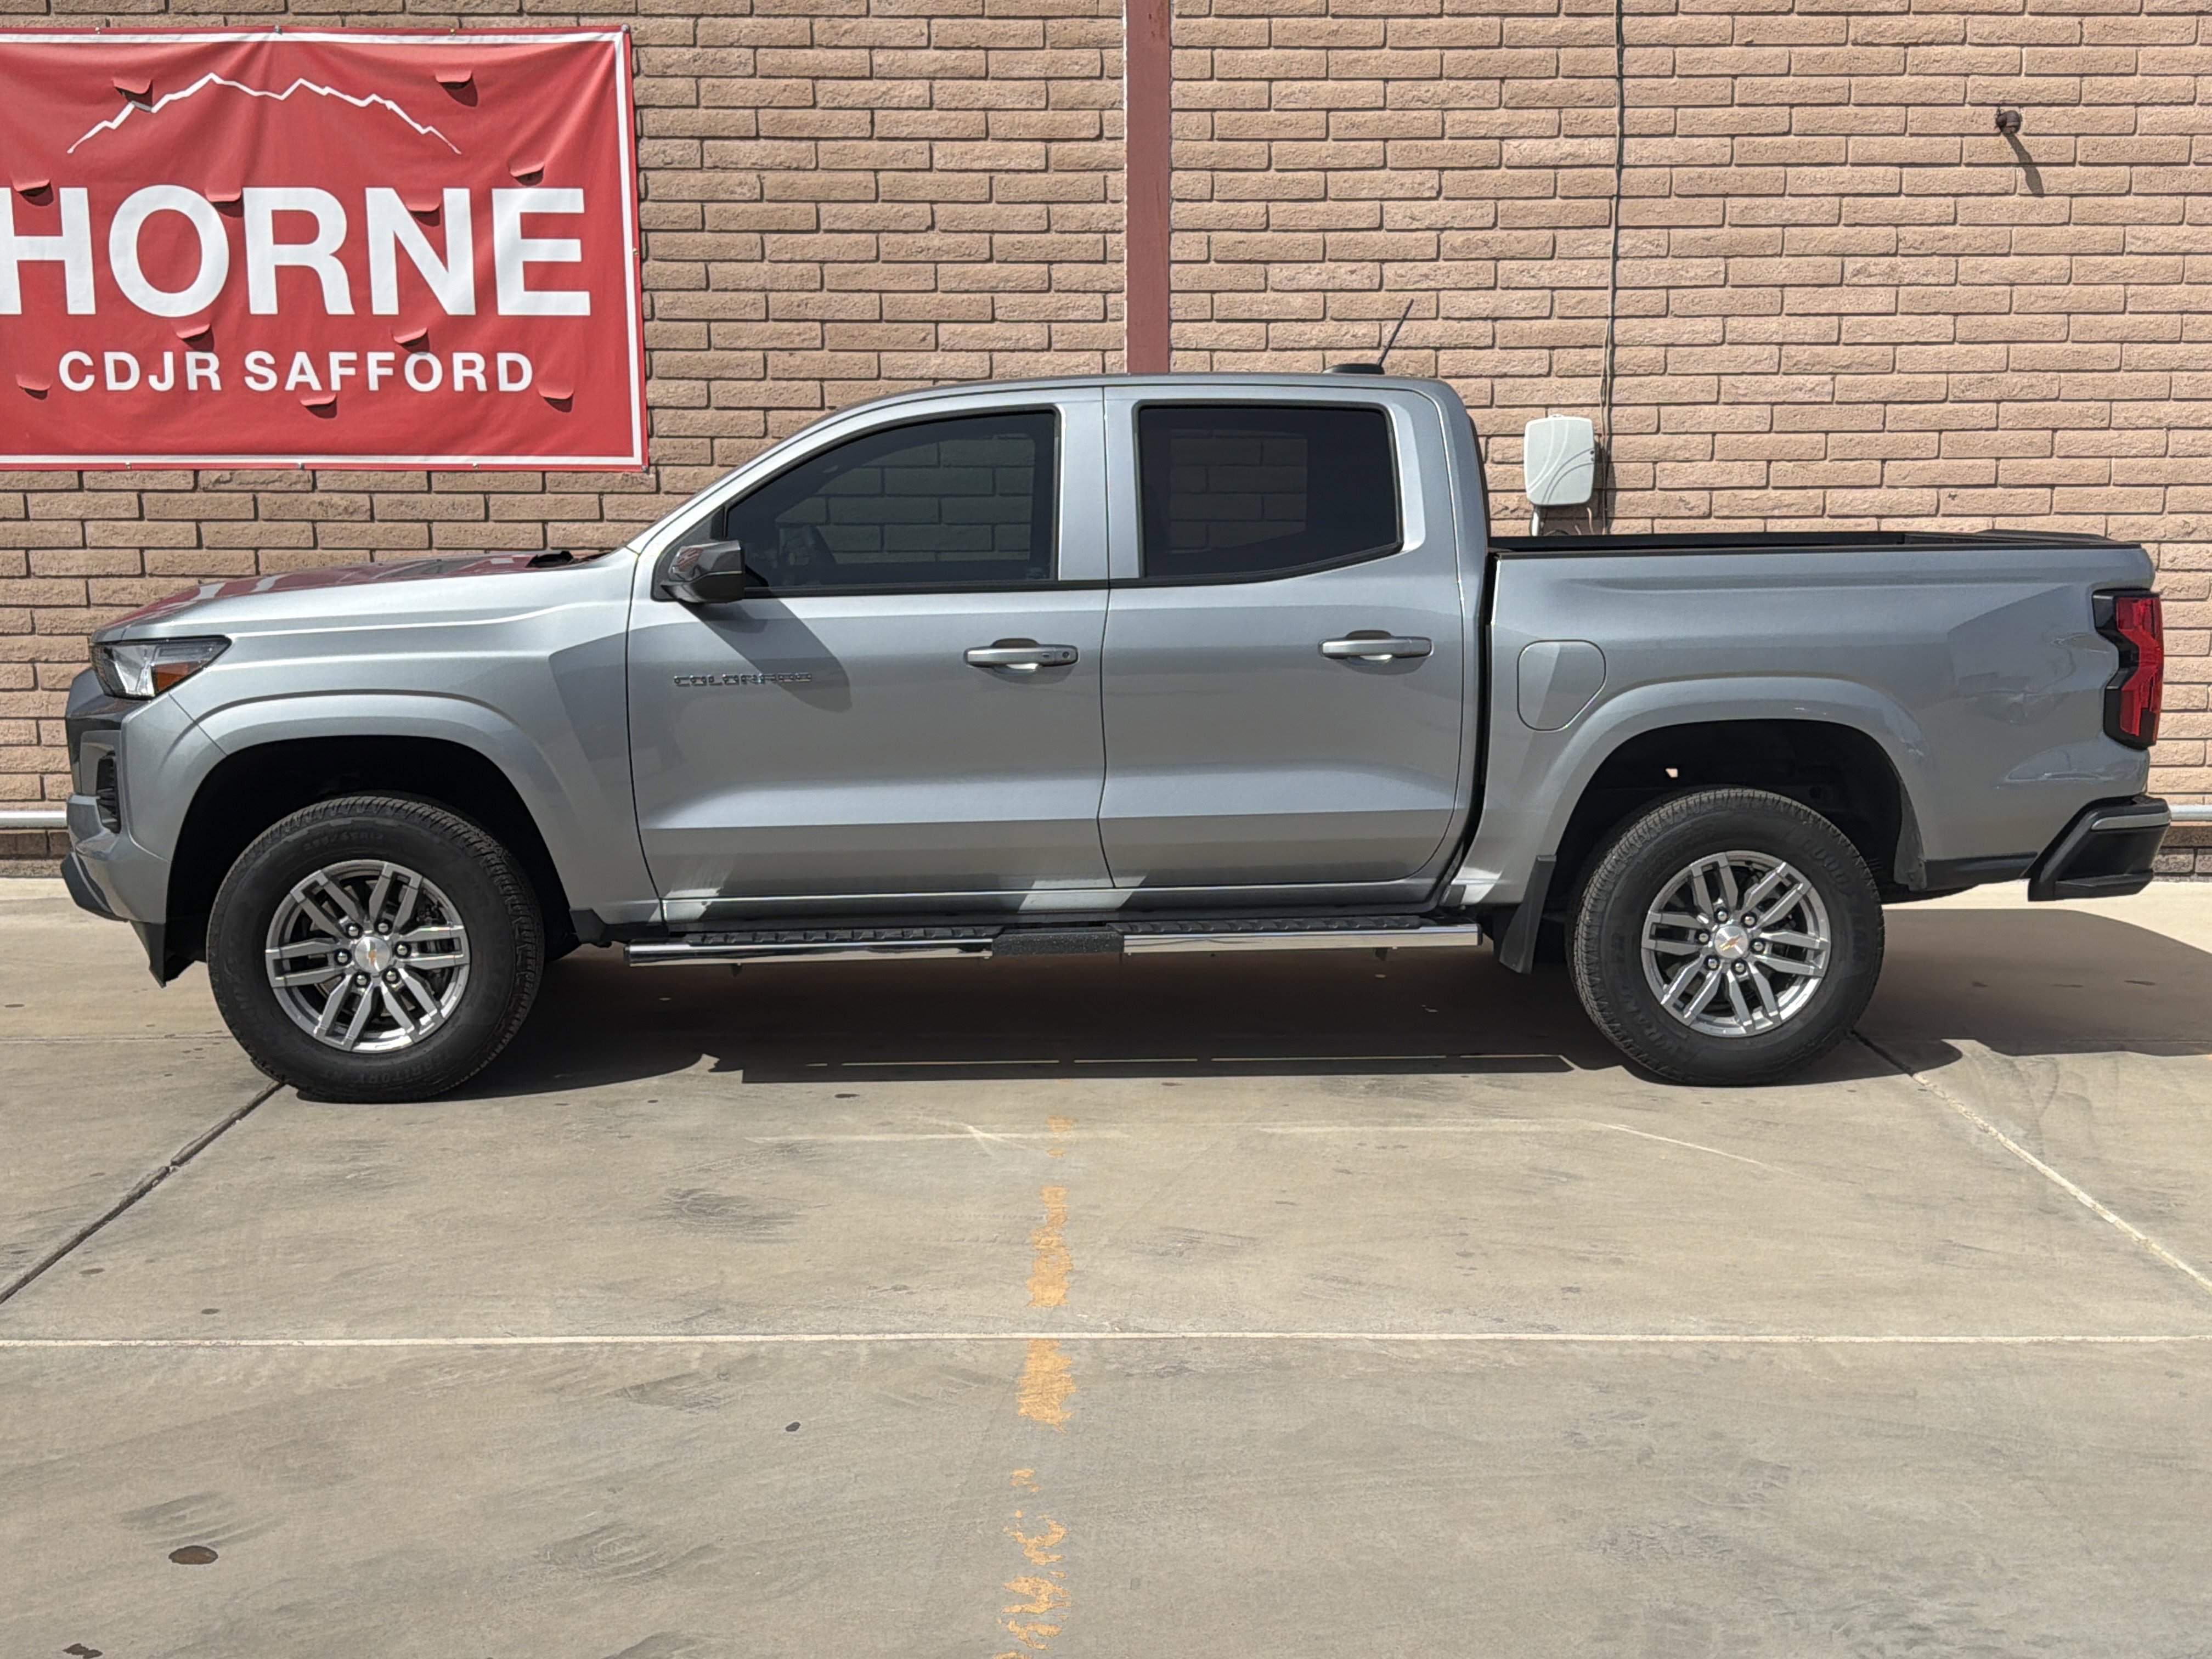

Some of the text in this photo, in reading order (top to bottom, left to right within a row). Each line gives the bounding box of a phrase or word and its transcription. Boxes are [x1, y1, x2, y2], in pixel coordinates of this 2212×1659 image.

[0, 185, 591, 318] HORNE
[59, 351, 533, 392] CDJR SAFFORD
[674, 672, 812, 686] COLORADO
